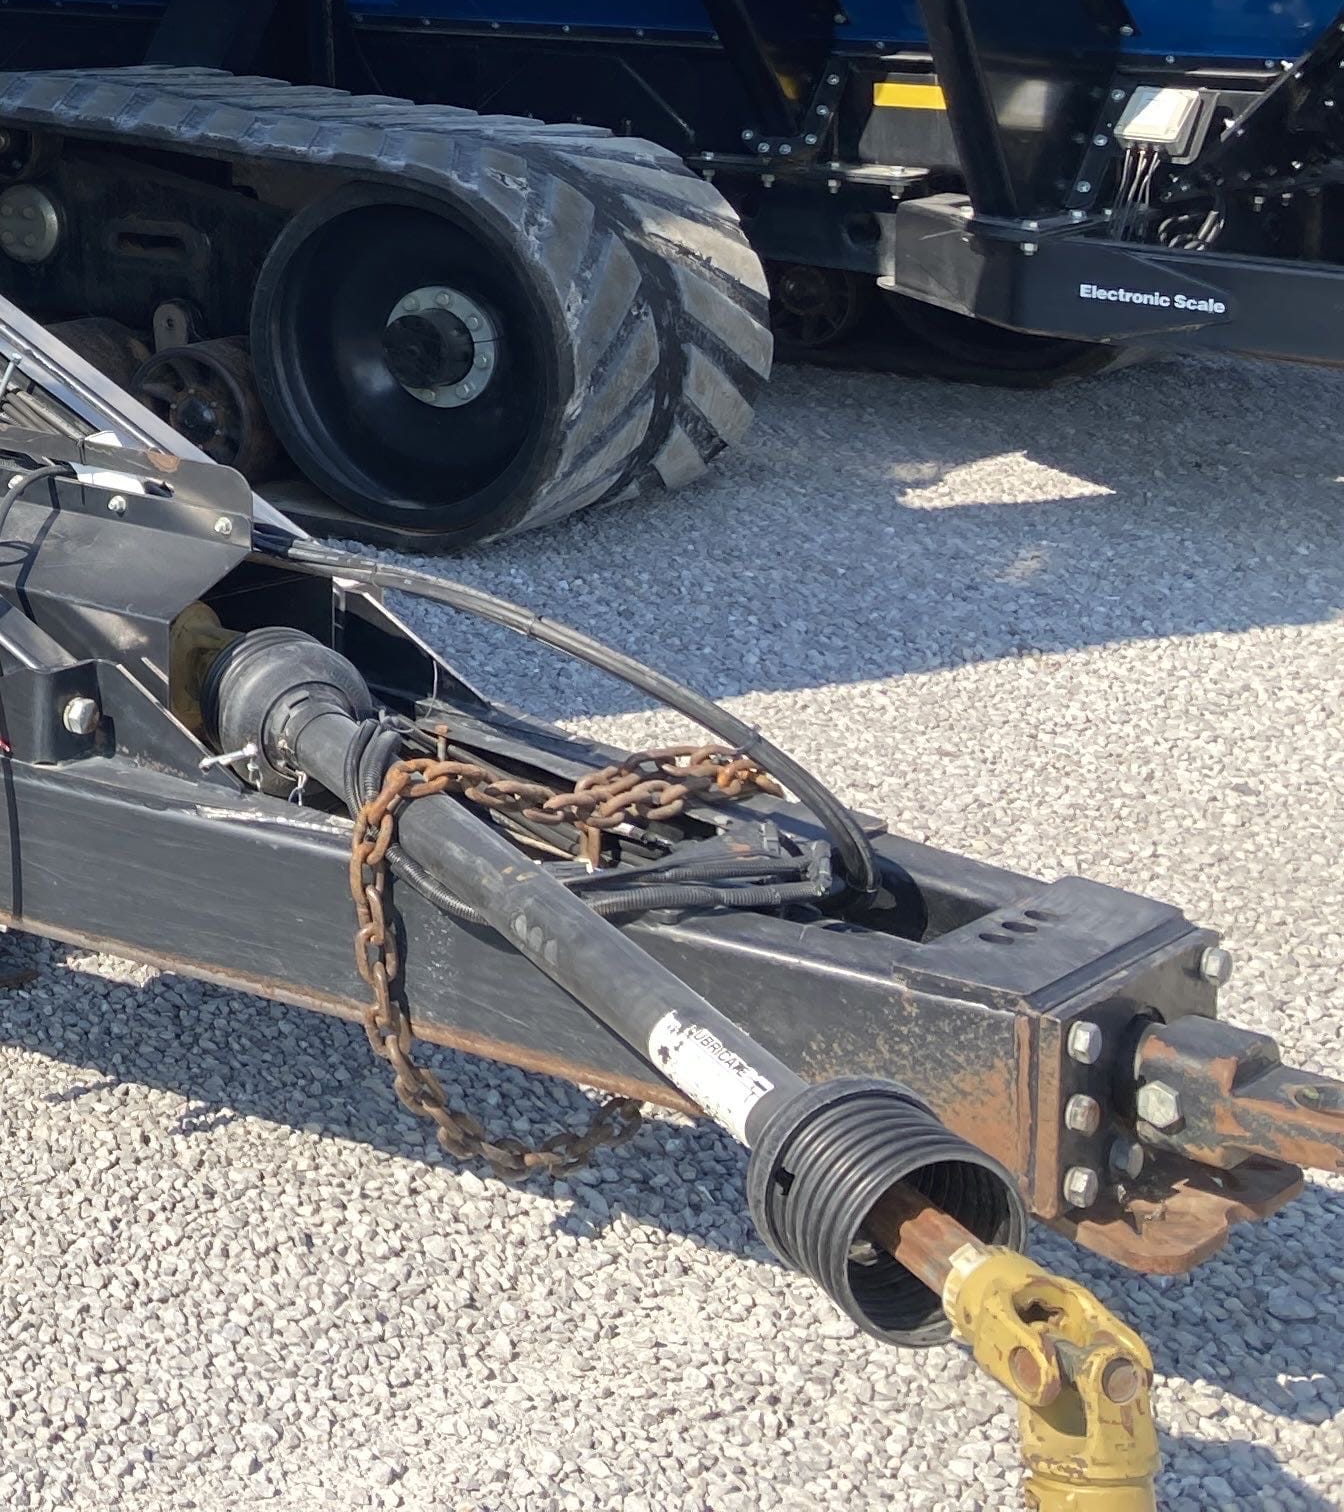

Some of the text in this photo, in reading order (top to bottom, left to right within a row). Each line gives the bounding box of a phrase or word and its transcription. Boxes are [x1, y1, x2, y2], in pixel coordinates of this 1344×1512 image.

[1079, 284, 1226, 314] Electronic Scale
[687, 1028, 748, 1077] UBRICATE
